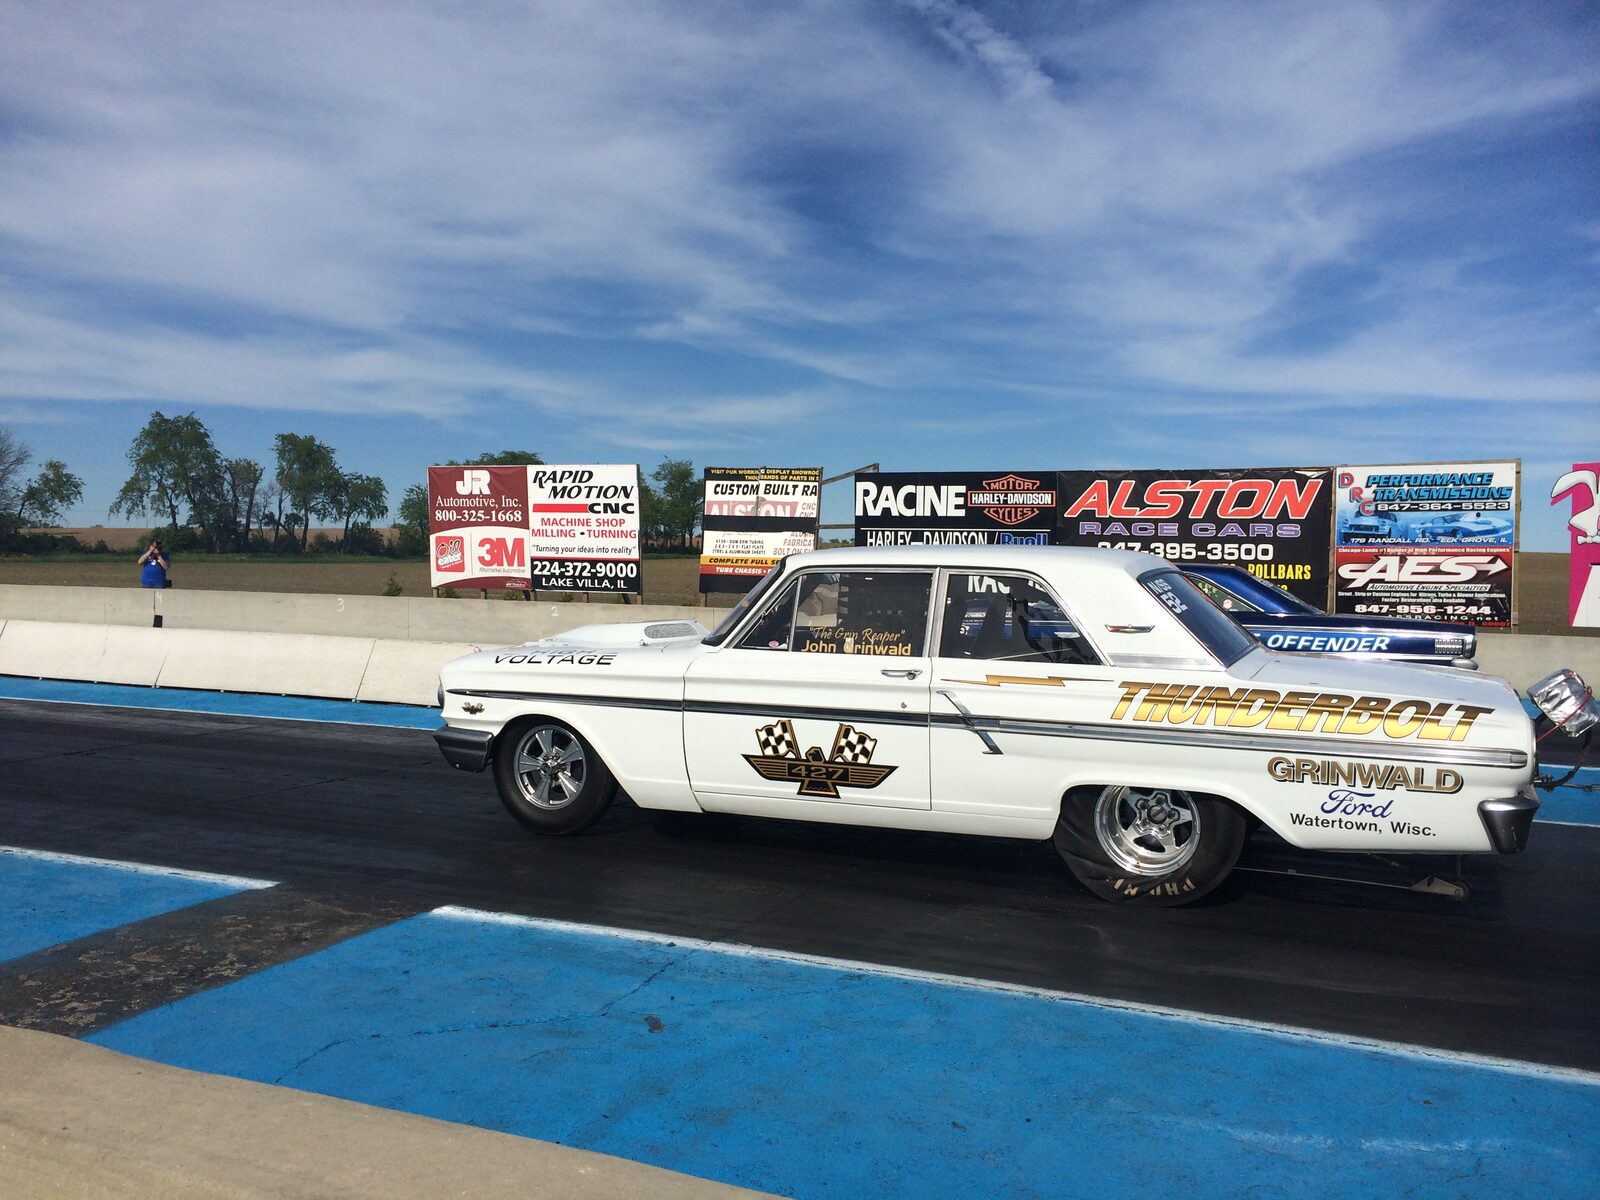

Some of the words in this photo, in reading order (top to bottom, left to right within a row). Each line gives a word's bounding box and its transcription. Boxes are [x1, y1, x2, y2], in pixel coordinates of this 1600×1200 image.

[456, 470, 491, 495] JR
[533, 470, 594, 488] RAPID
[990, 478, 1033, 490] MOTOR
[1366, 472, 1494, 488] PERFORMANCE
[548, 485, 634, 499] MOTION
[714, 484, 759, 495] CUSTOM
[764, 484, 799, 496] BUILT
[801, 485, 817, 496] RA
[1373, 487, 1513, 502] TRANSMISSIONS
[436, 495, 499, 508] Automotive,
[502, 496, 522, 507] Inc.
[855, 481, 967, 517] RACINE
[971, 493, 1052, 505] HARLEY-DAVIDSON
[1064, 479, 1323, 519] ALSTON
[587, 503, 635, 514] CNC
[1377, 503, 1509, 511] 847-364-5523
[435, 510, 522, 522] 800-325-1668
[989, 508, 1033, 522] CYCLES
[541, 518, 592, 527] MACHINE
[595, 518, 626, 528] SHOP
[1079, 522, 1179, 536] RACE
[1191, 523, 1301, 537] CARS
[532, 529, 576, 538] MILLING
[587, 529, 637, 539] TURNING
[478, 538, 525, 567] 3M
[560, 546, 576, 554] your
[577, 545, 594, 553] ideas
[611, 546, 636, 555] reality"
[533, 561, 637, 577] 224-372-9000
[1338, 555, 1508, 589] AES
[542, 577, 574, 587] LAKE
[577, 579, 615, 589] VILLA,
[617, 579, 627, 588] IL
[337, 598, 344, 612] 3
[1354, 604, 1492, 615] 847-956-1244
[801, 640, 837, 653] John
[843, 640, 912, 656] Grinwald
[1267, 634, 1391, 652] OFFENDER
[495, 654, 617, 665] VOLTAGE
[1111, 681, 1495, 742] THUNDERBOLT
[791, 766, 845, 779] 427
[1266, 756, 1464, 794] GRINWALD
[1320, 789, 1394, 819] Ford
[1290, 812, 1382, 835] Watertown,
[1391, 821, 1437, 837] Wisc.
